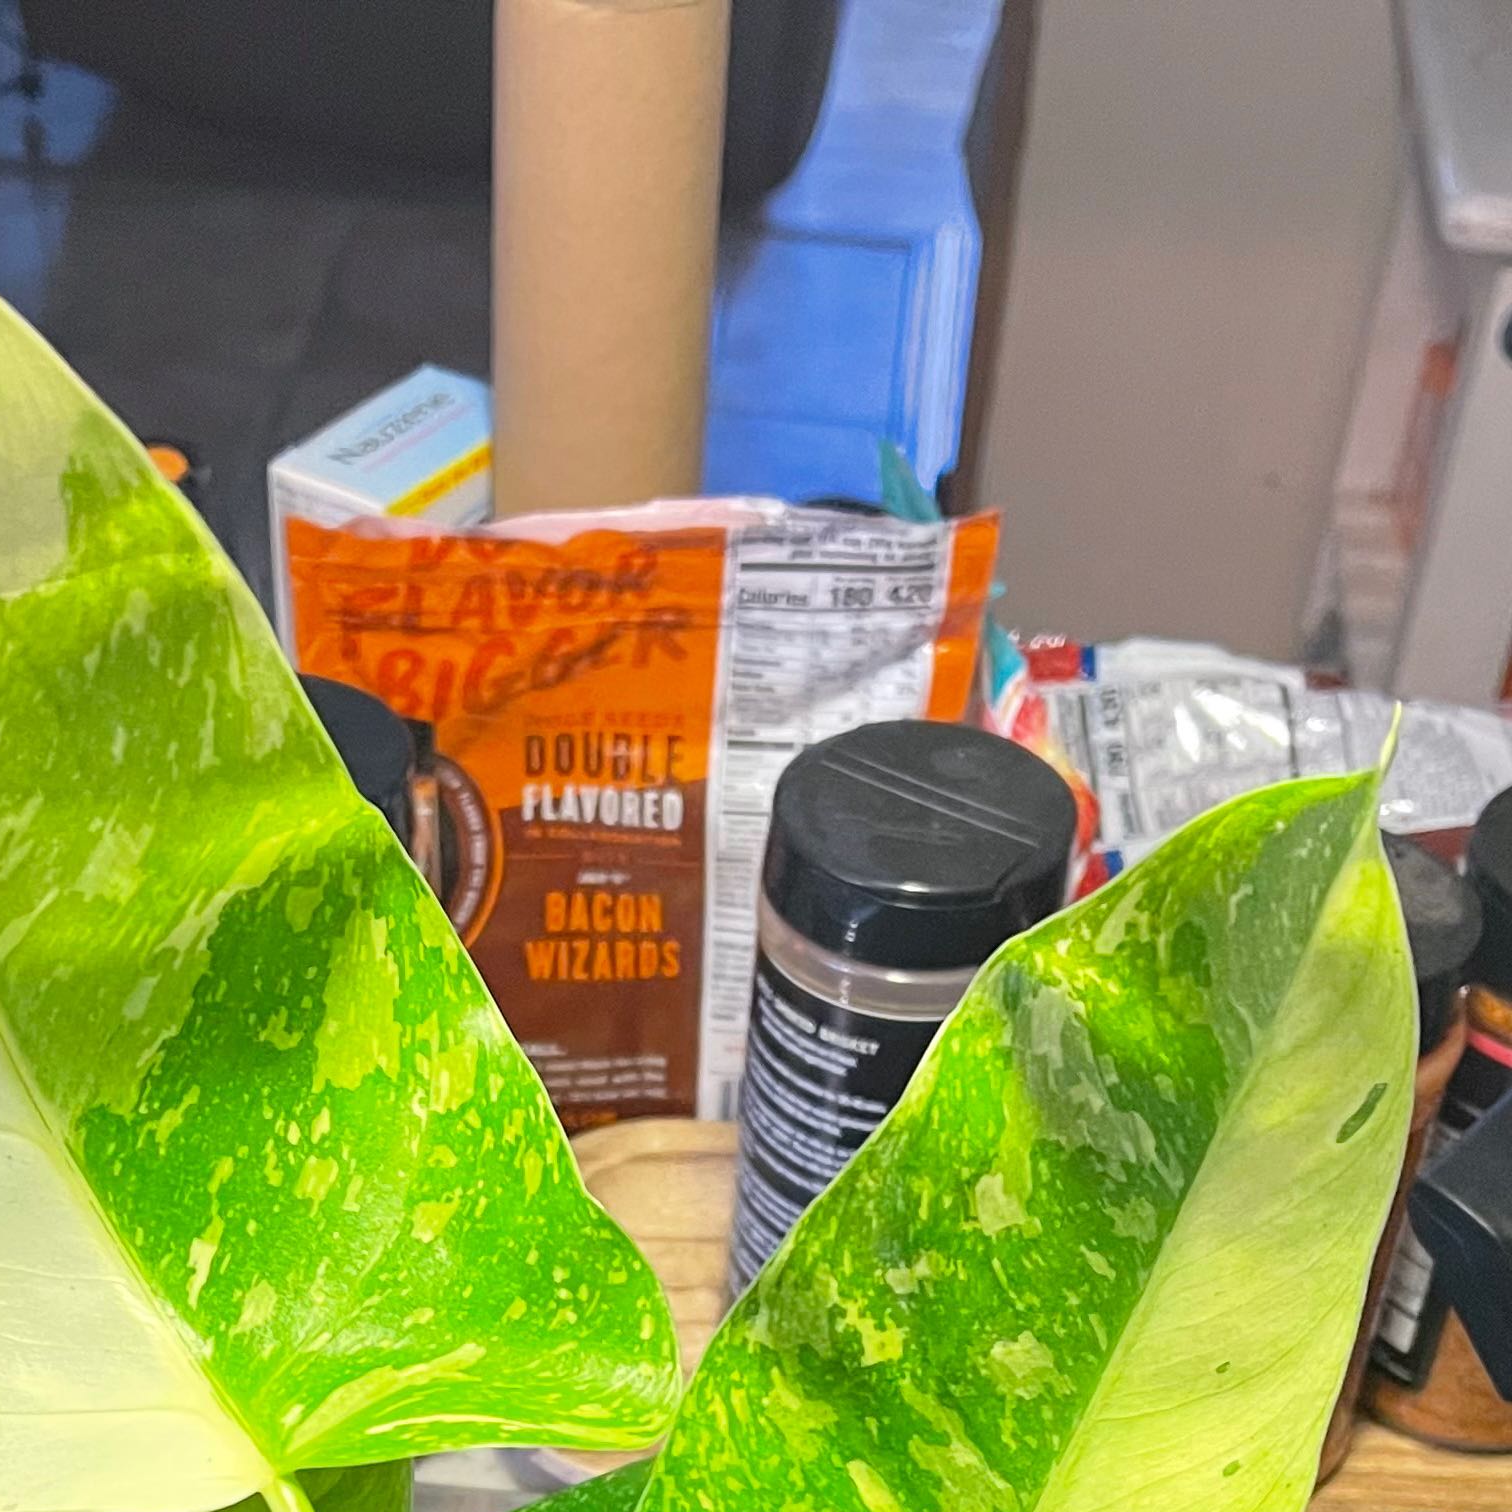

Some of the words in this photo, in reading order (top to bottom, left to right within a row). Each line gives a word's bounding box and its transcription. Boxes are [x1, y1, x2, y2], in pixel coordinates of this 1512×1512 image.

[525, 731, 684, 784] DOUBLE
[521, 783, 684, 831] FLAVORED
[544, 890, 664, 933] BACON
[524, 938, 682, 982] WIZARDS
